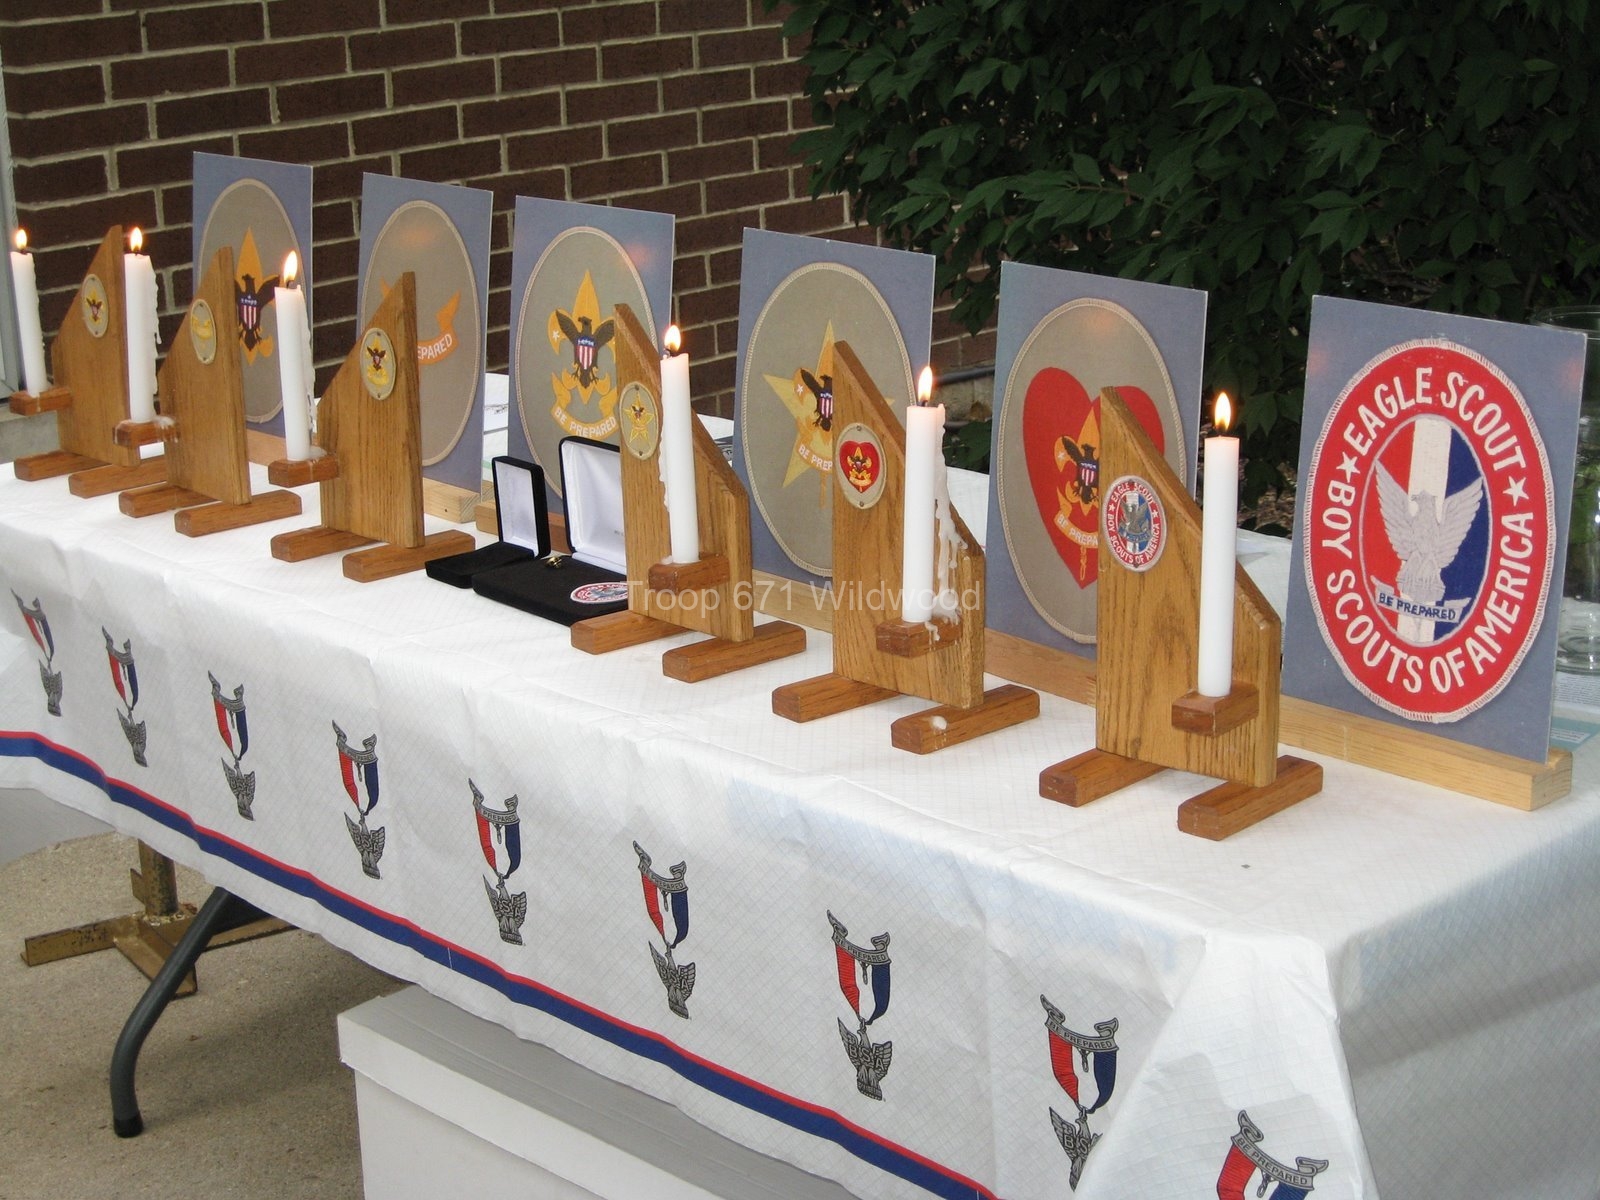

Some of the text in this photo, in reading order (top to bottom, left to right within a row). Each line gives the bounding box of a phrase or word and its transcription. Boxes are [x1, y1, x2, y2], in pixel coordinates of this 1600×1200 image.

[554, 406, 617, 438] BE PREPARED
[1343, 367, 1527, 472] EAGLE SCOUT
[798, 444, 833, 471] BE PREP
[1111, 482, 1154, 505] EAGLE SCOUT
[1107, 513, 1116, 532] BOY
[1069, 527, 1098, 546] PREPA
[1110, 535, 1134, 564] SCOUTS
[1145, 523, 1160, 561] AMERICA
[1135, 555, 1145, 564] OF
[1322, 480, 1535, 694] BOY SCOUTS OF AMERICA
[1379, 593, 1456, 620] BE PREPARED
[1063, 1031, 1113, 1049] PREPARED
[1237, 1138, 1308, 1185] BE PREPARED
